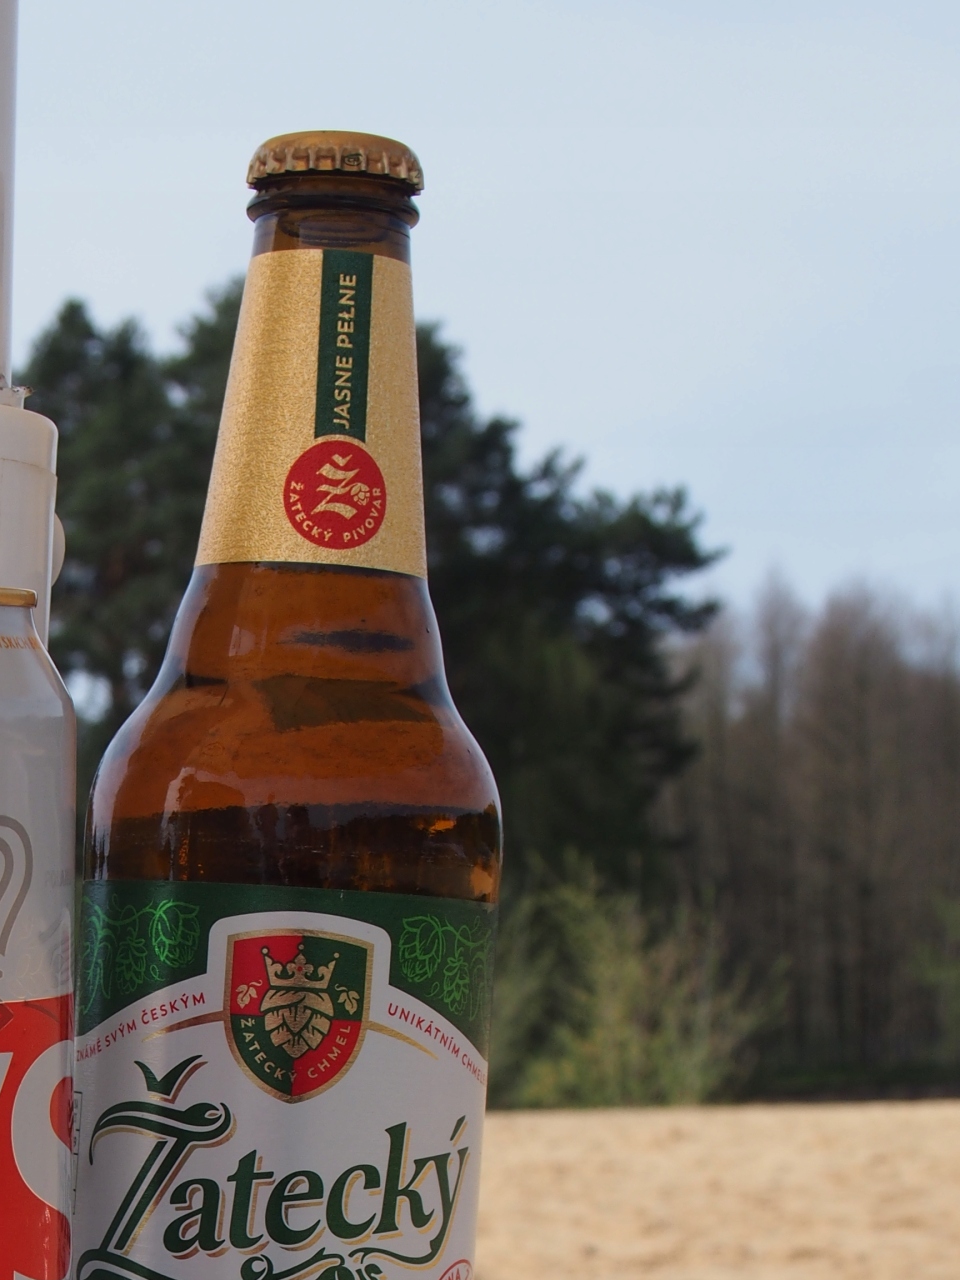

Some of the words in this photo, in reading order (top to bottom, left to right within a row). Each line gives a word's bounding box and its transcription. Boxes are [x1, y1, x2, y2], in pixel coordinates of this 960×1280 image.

[336, 273, 357, 348] PEŁNE
[333, 355, 353, 429] JASNE
[289, 480, 333, 542] ŽATECKÝ
[342, 487, 382, 543] PIVOVAR
[76, 1038, 102, 1062] ZNÁMÉ
[104, 1019, 137, 1047] SVÝM
[141, 992, 206, 1025] ČESKÝM
[240, 1017, 298, 1082] ŽATECKÝ
[307, 1025, 351, 1079] CHMEL
[387, 1002, 461, 1058] UNIKÁTNÍM
[461, 1053, 487, 1086] CHMELE
